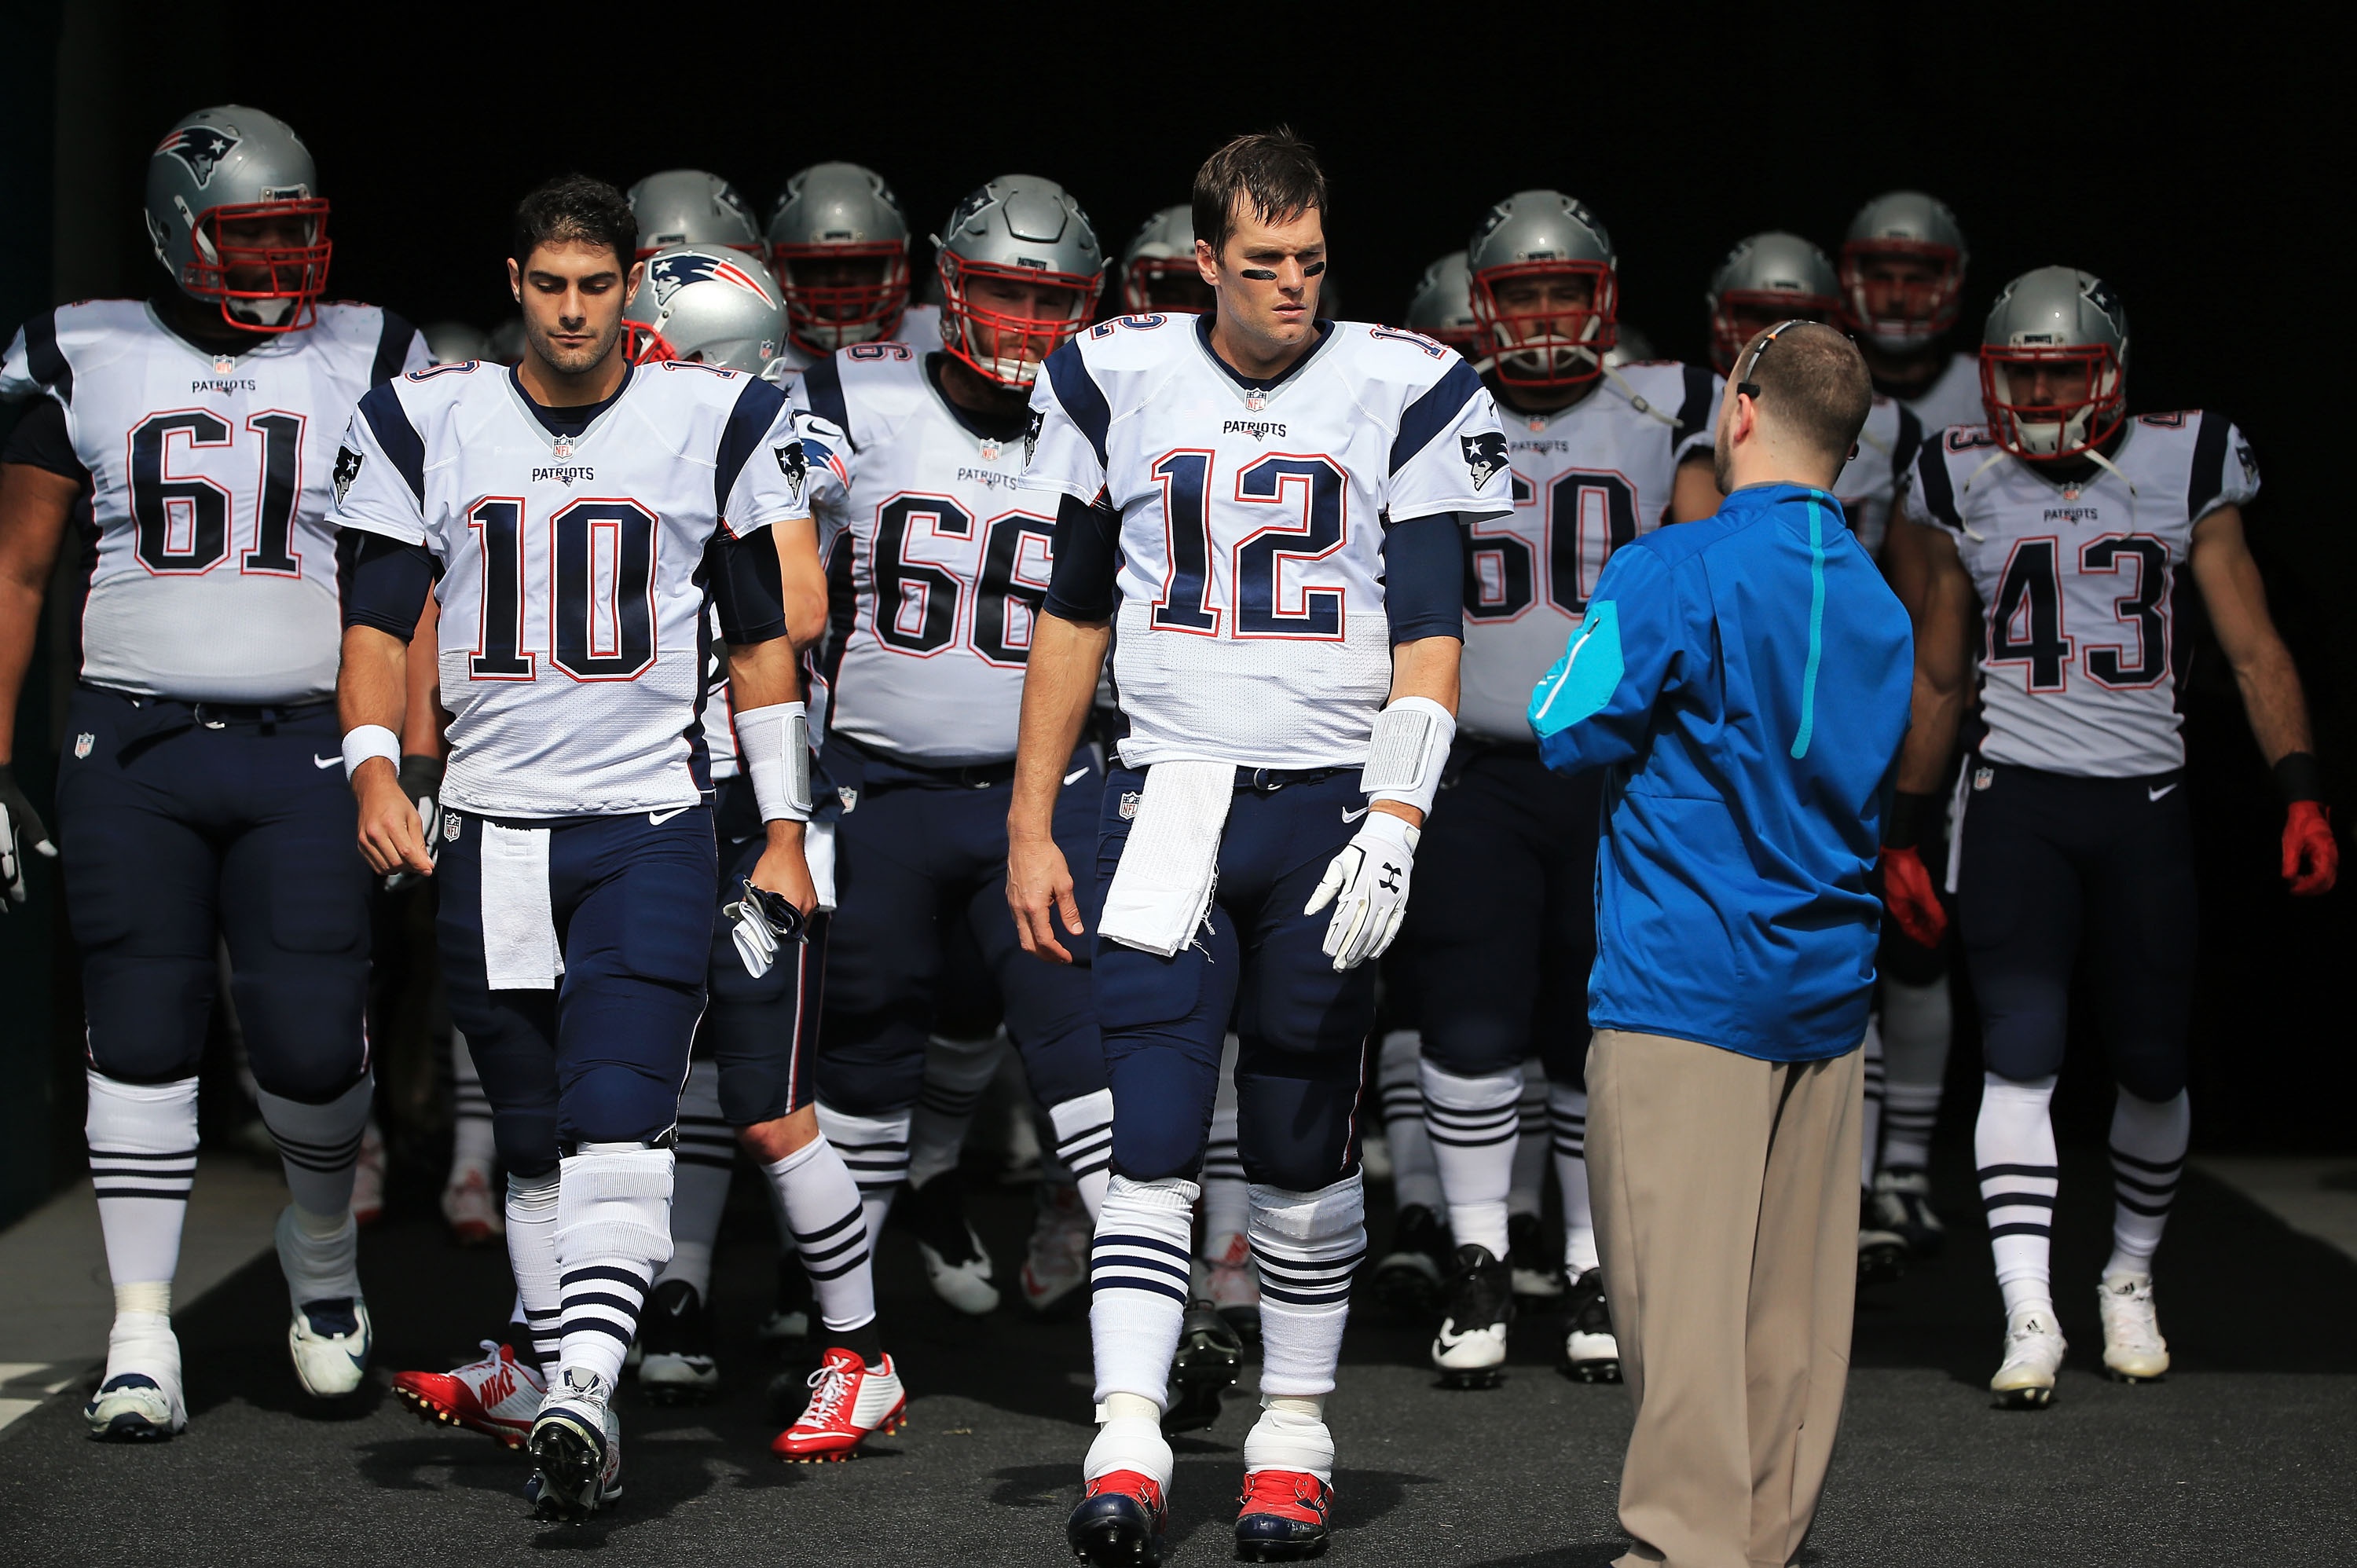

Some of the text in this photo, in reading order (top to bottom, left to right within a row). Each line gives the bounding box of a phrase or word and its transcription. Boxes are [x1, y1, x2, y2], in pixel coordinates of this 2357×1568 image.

[192, 379, 255, 393] PATRIOTS
[1248, 398, 1264, 410] NFL
[1223, 420, 1286, 437] PATRIOTS
[555, 445, 572, 456] NFL
[532, 467, 594, 482] PATRIOTS
[958, 467, 1017, 490] PATRIOTS
[127, 407, 307, 580] 61
[2044, 507, 2099, 522] PATRIOTS
[1149, 448, 1349, 642] 12
[1463, 467, 1642, 625] 60
[467, 496, 659, 683] 10
[870, 491, 1057, 669] 66
[1986, 533, 2171, 694] 43
[479, 1366, 516, 1410] NIKE
